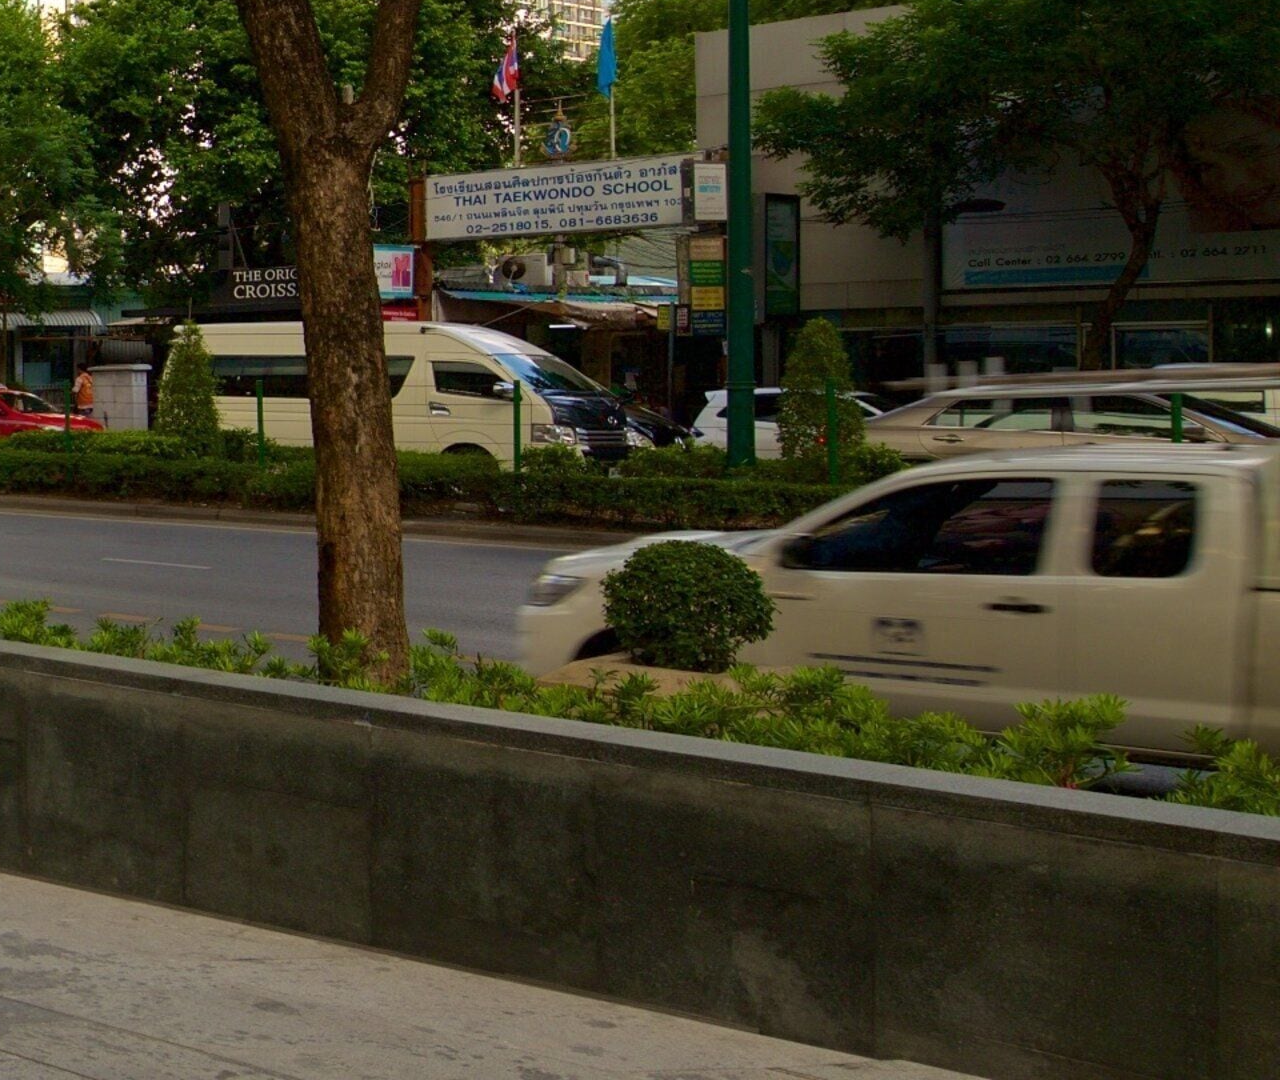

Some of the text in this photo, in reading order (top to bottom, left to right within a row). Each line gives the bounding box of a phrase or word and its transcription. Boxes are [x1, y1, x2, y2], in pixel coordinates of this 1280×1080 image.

[454, 180, 673, 207] THAI TAEKWONDO SCHOOL
[559, 213, 658, 228] 081-6683636
[968, 258, 990, 268] Call
[995, 258, 1031, 266] Center
[1046, 255, 1060, 264] 02
[1066, 253, 1088, 263] 664
[1095, 252, 1126, 262] 2799
[1181, 248, 1196, 258] 02
[233, 270, 261, 282] THE
